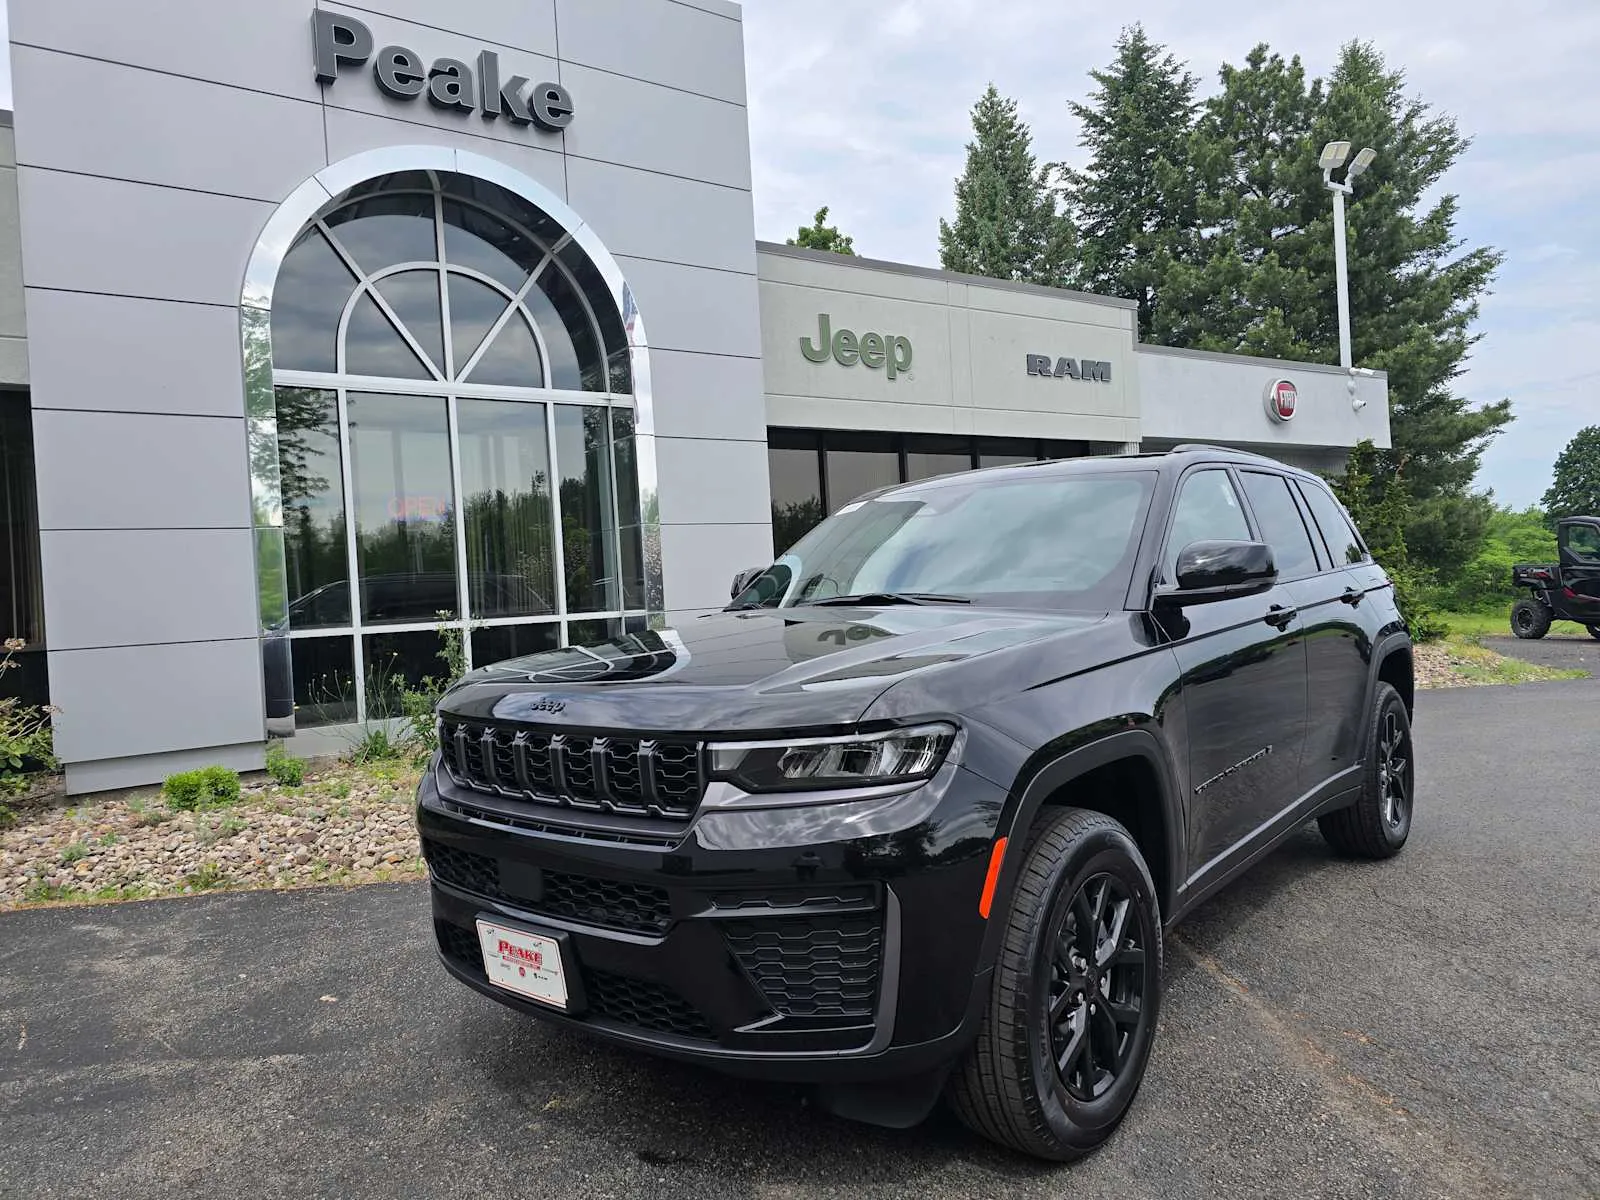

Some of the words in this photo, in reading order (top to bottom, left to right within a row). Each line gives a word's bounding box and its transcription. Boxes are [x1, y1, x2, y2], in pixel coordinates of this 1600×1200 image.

[312, 8, 575, 132] Peake
[799, 313, 913, 380] Jeep
[1026, 353, 1112, 382] RAM
[498, 940, 543, 964] PEAKE
